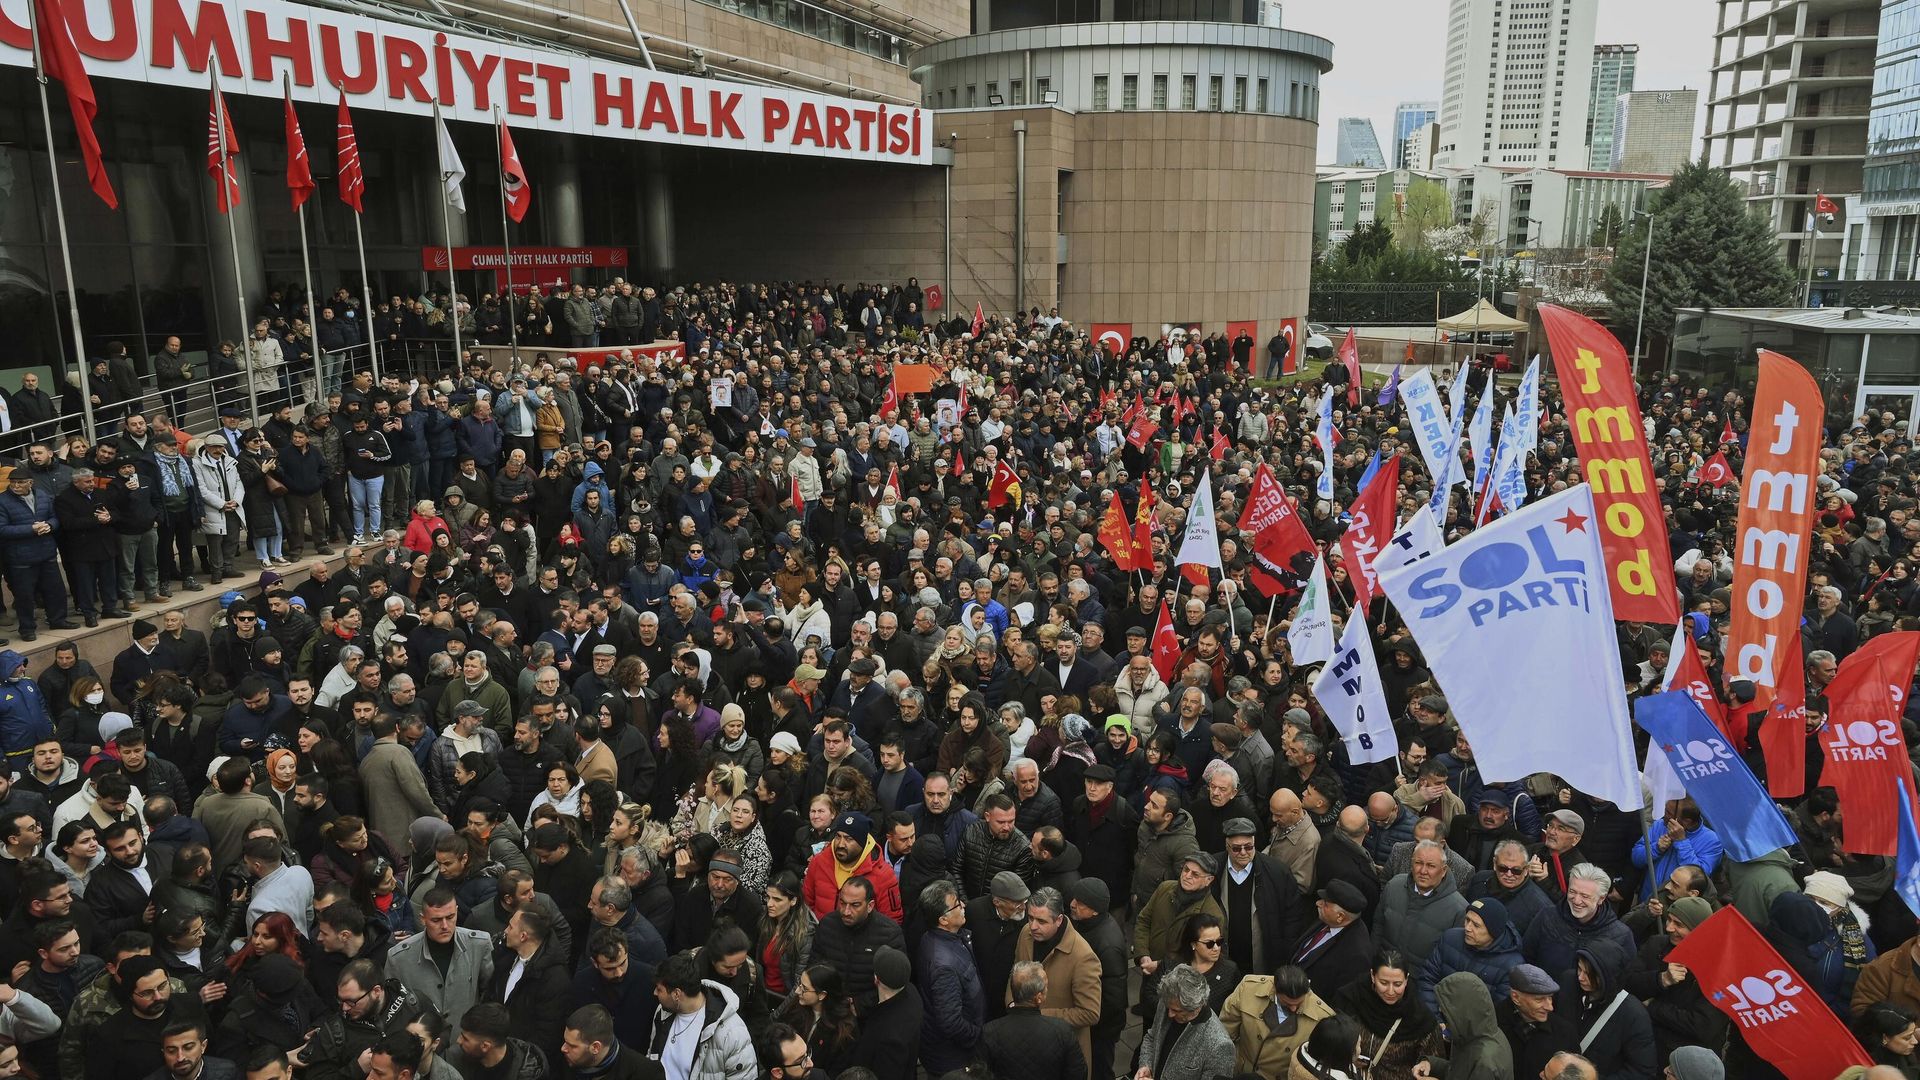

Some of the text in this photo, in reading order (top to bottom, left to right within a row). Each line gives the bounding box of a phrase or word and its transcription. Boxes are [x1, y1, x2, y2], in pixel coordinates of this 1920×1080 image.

[593, 72, 745, 140] HALK
[763, 103, 921, 156] PARTİSİ
[472, 250, 593, 266] CUMHURİYET HALK PARTİSİ
[1408, 524, 1586, 619] SOL
[1333, 641, 1374, 750] MMOB
